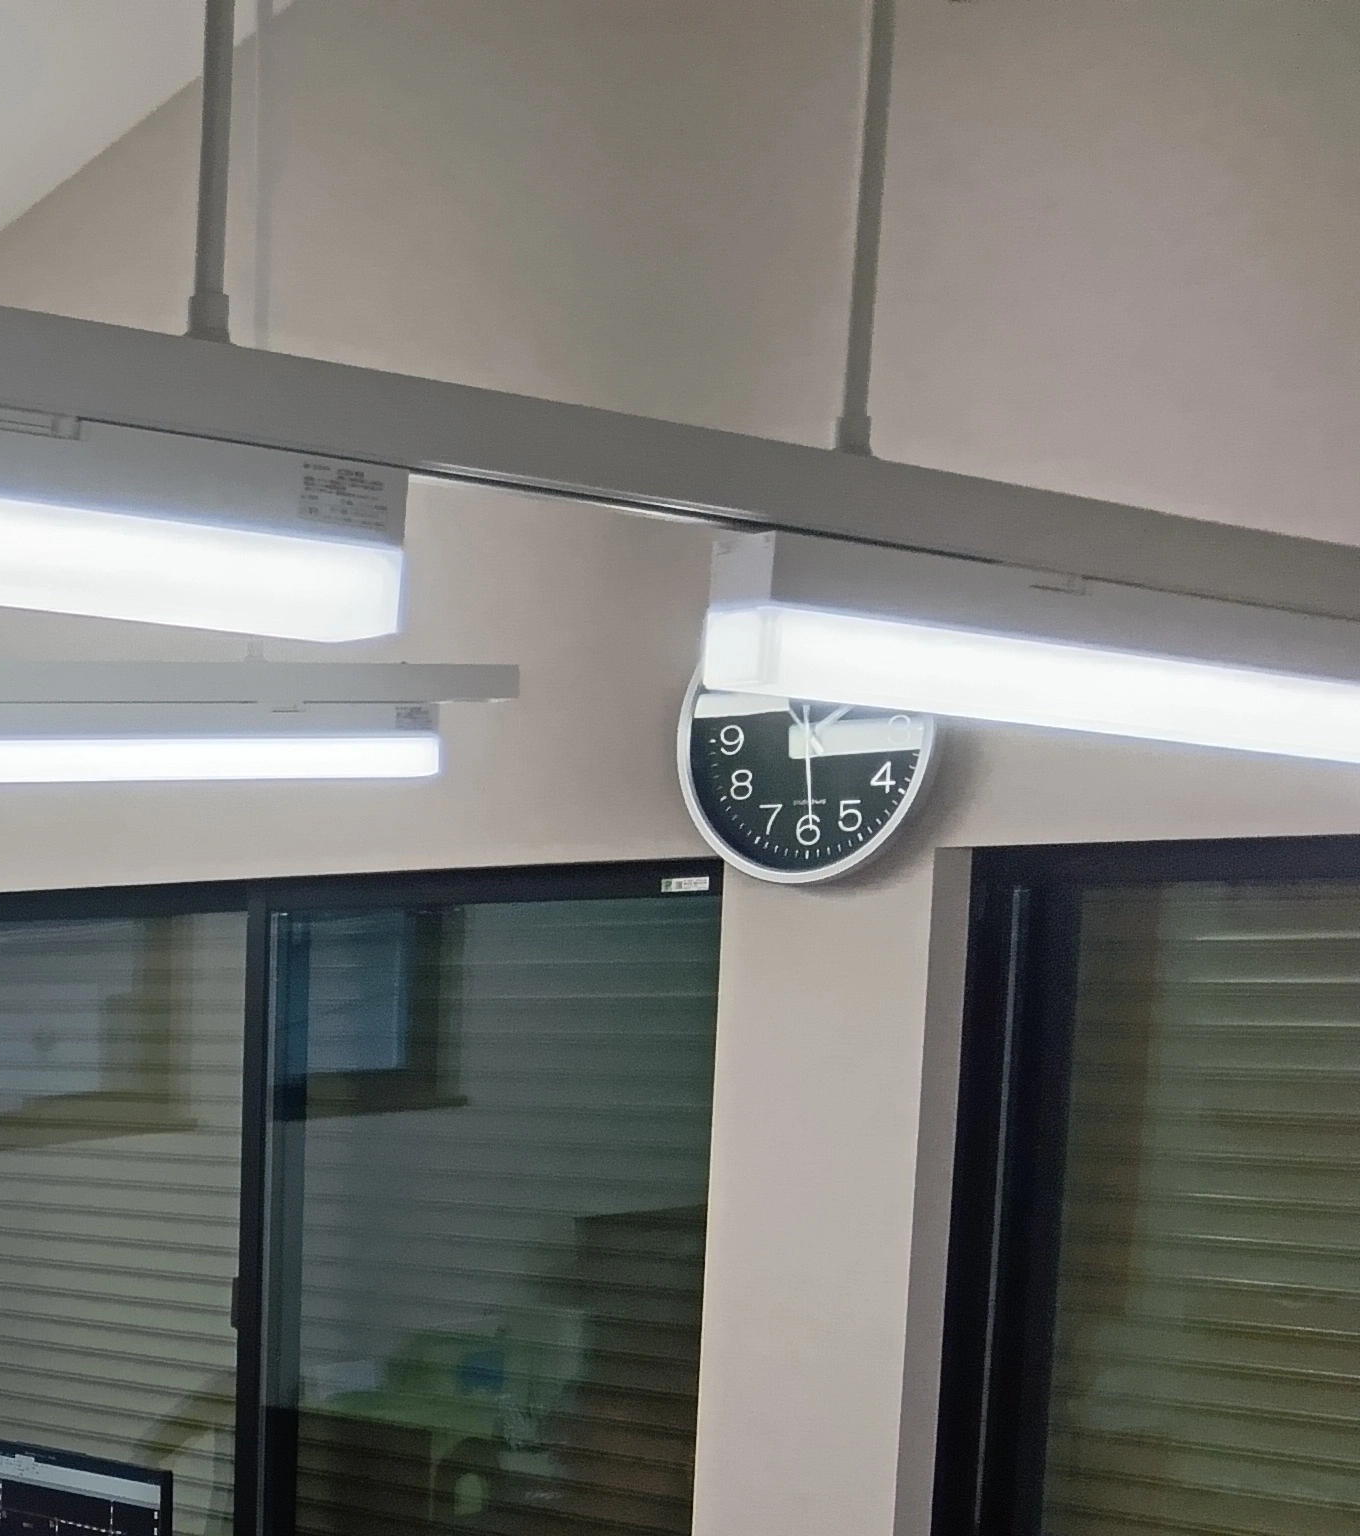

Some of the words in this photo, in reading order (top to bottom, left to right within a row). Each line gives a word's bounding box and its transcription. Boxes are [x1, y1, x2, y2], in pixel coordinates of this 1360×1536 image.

[720, 725, 744, 756] 9
[887, 714, 912, 745] 3
[730, 769, 753, 800] 8
[870, 761, 896, 793] 4
[759, 804, 783, 835] 7
[796, 814, 821, 846] 6
[838, 800, 862, 832] 5
